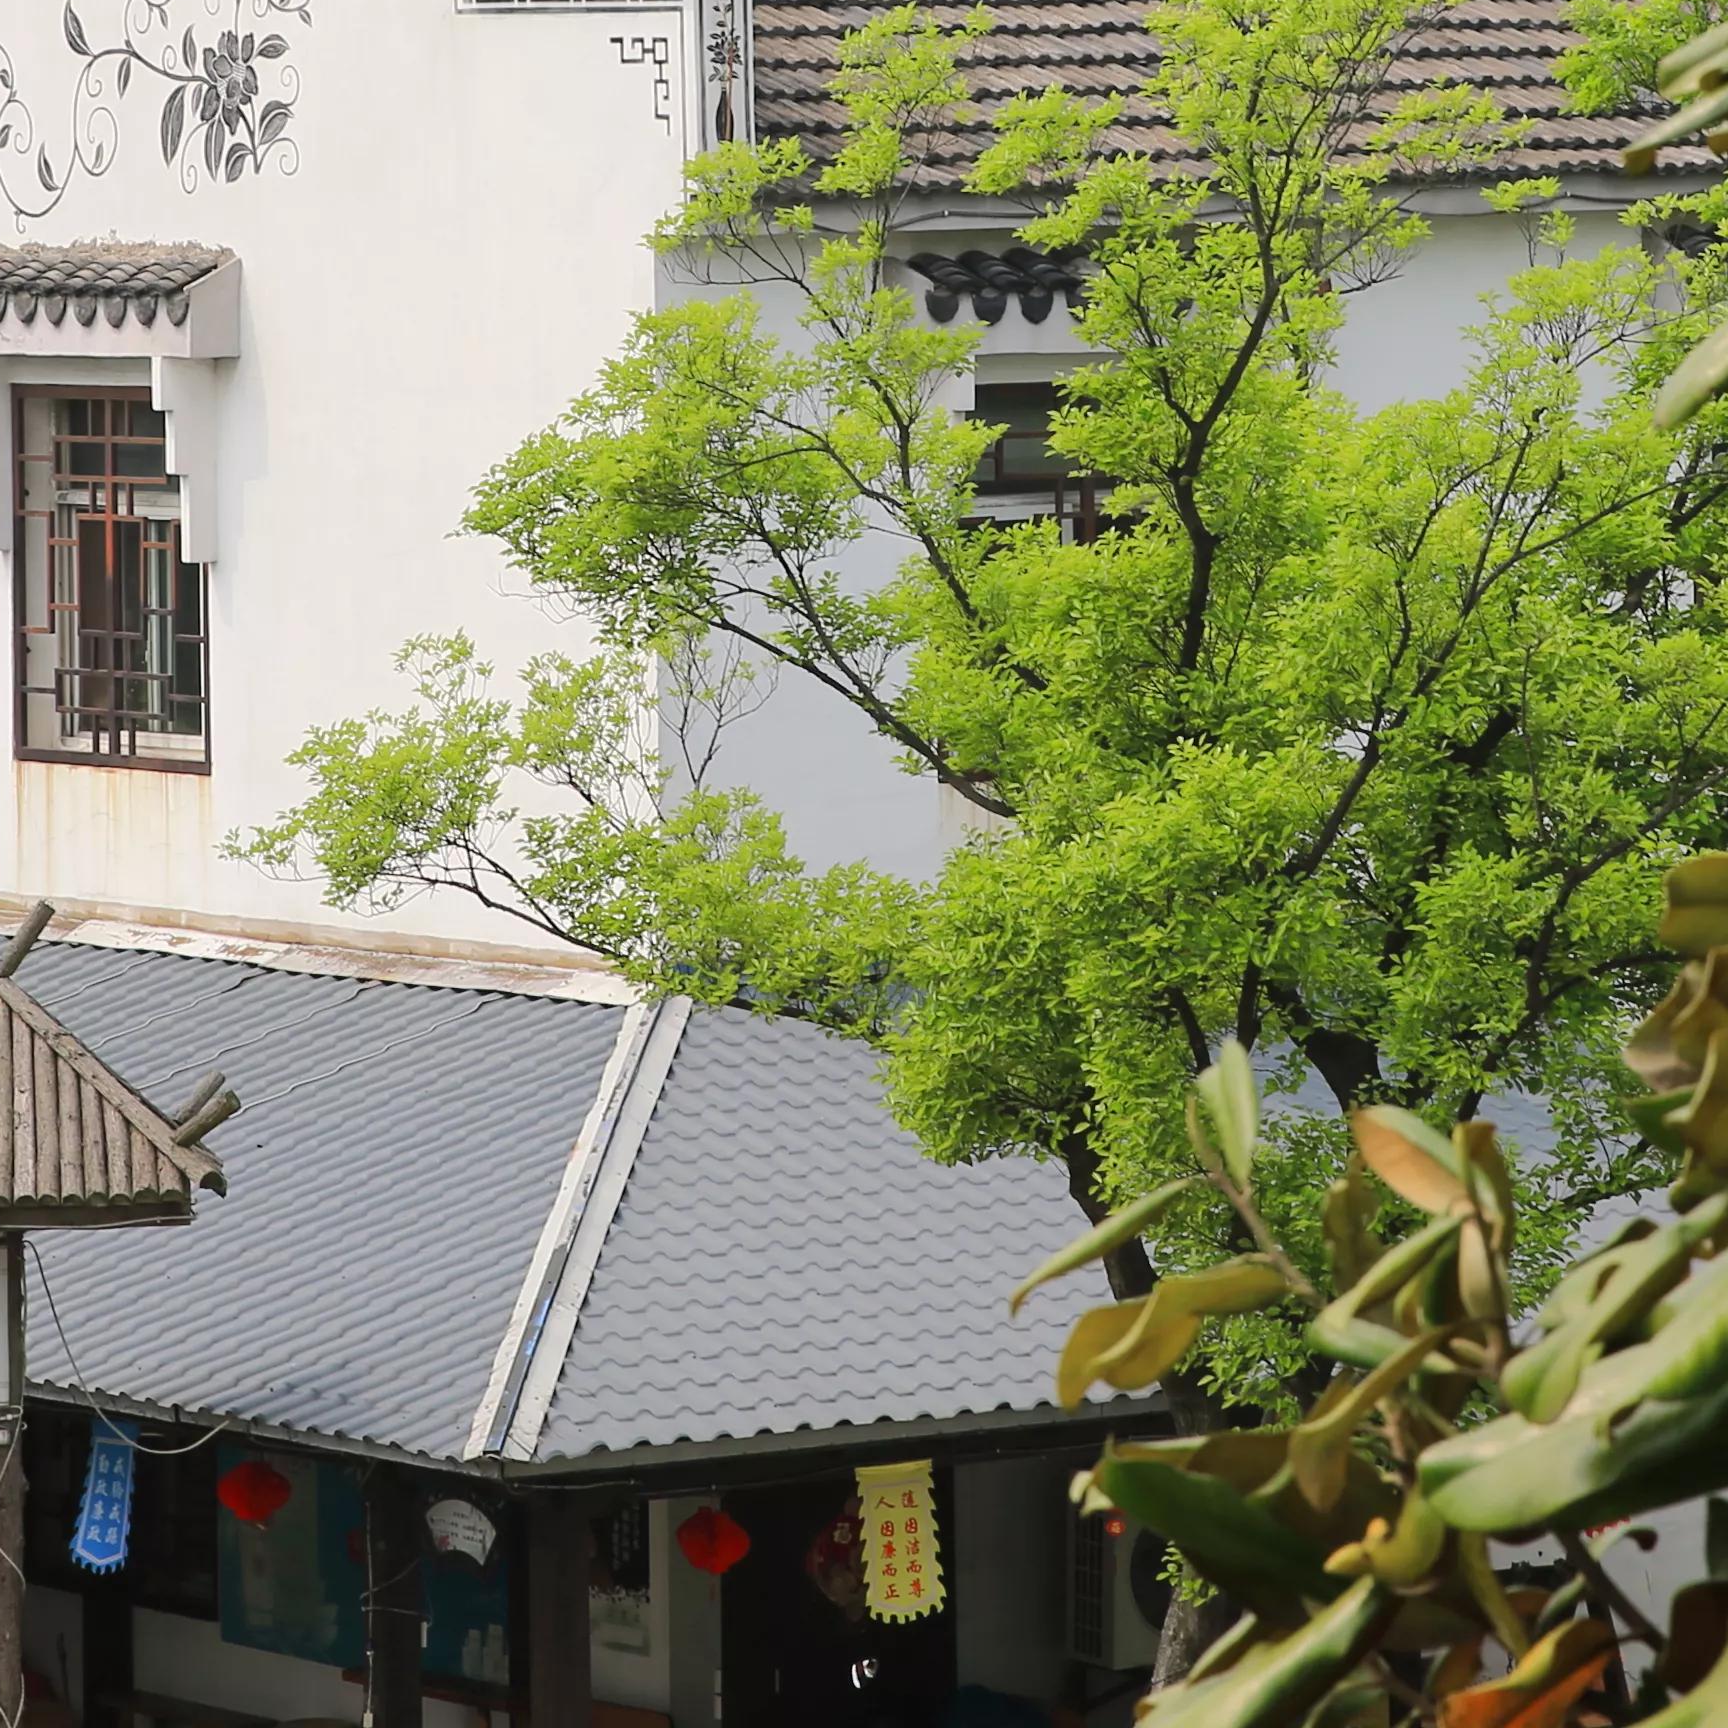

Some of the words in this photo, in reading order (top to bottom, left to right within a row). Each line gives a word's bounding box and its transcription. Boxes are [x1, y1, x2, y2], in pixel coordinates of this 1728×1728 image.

[874, 1495, 901, 1600] 人因廉而正
